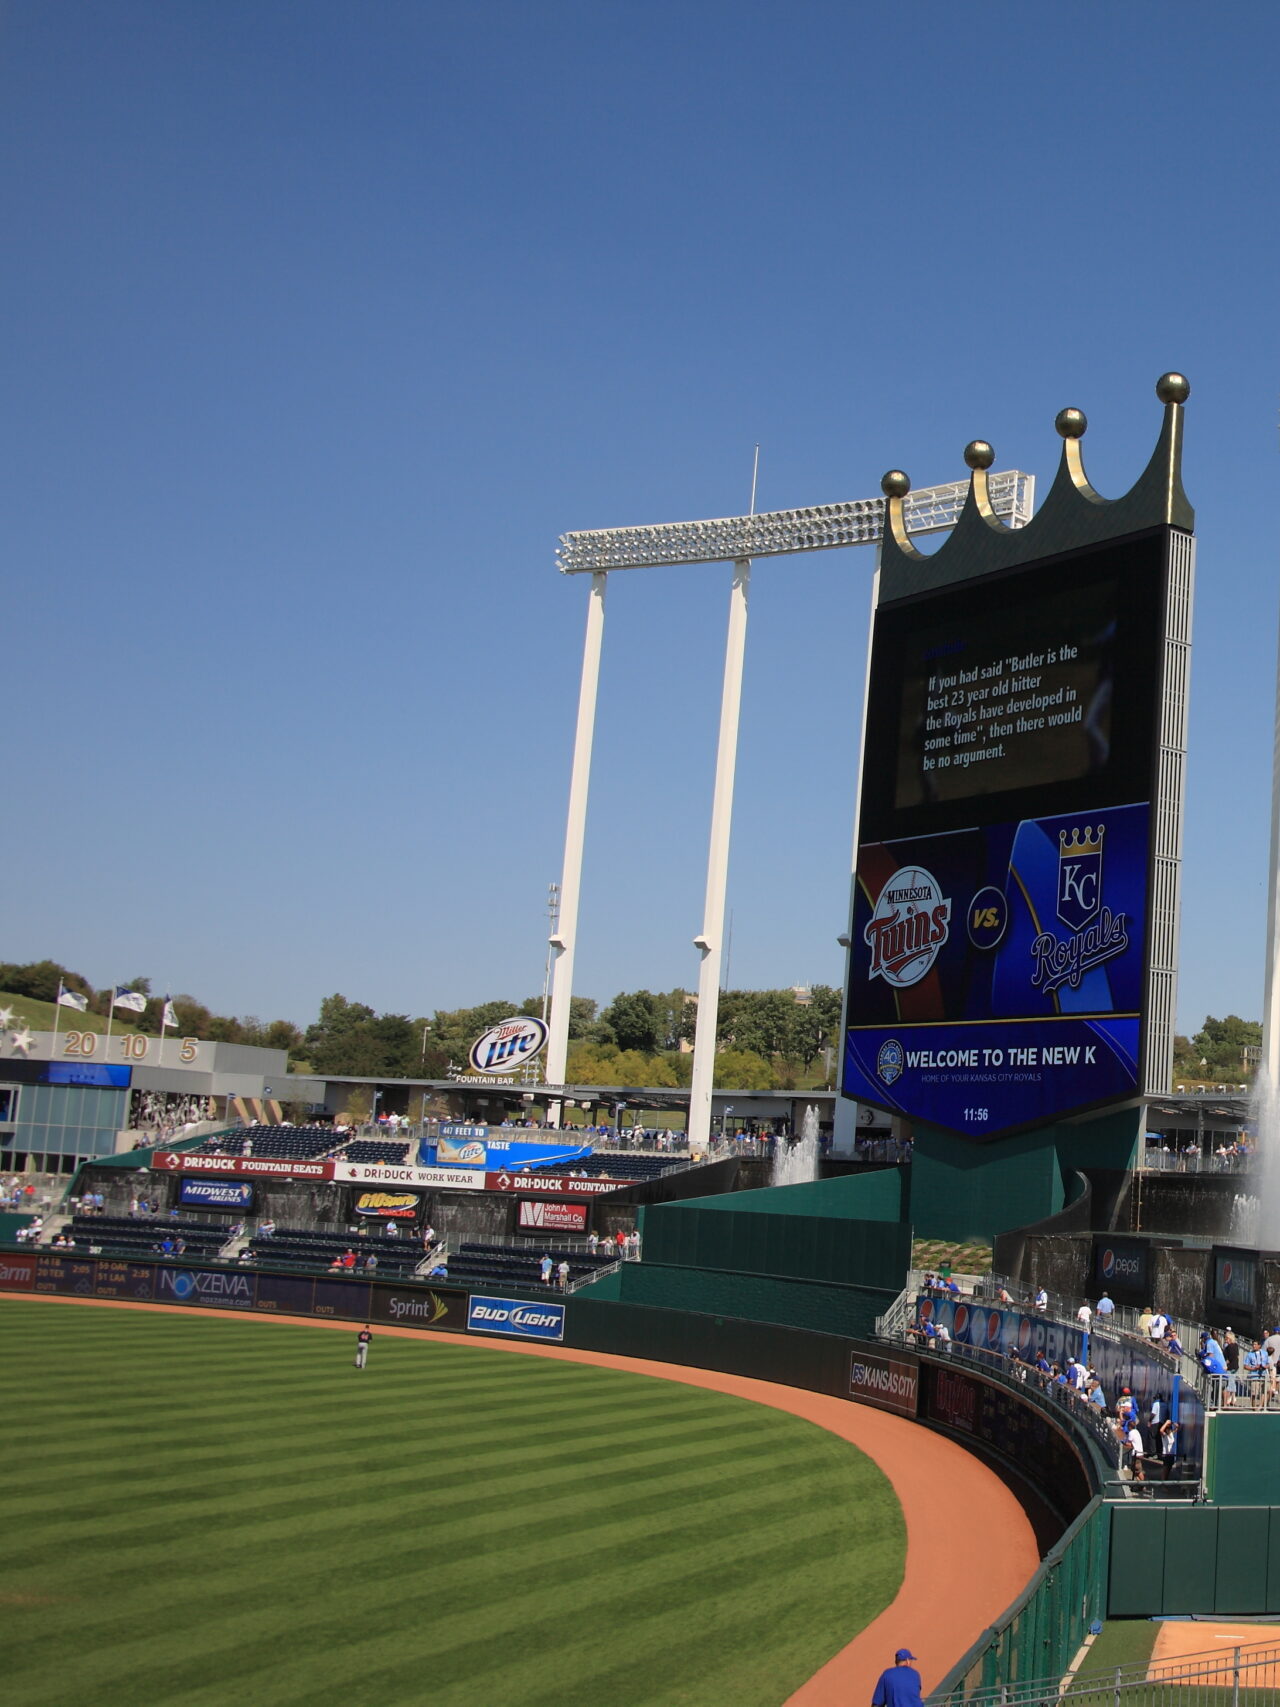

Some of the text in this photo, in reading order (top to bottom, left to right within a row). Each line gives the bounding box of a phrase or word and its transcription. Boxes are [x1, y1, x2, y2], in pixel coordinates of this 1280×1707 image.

[928, 644, 1078, 693] If you had said "Butler is the
[927, 675, 1042, 711] best 23 year old hitter
[926, 686, 1077, 731] the Royals have developed in
[924, 705, 1083, 751] some time", then there would
[923, 743, 1006, 771] be no argument.
[887, 886, 932, 904] MINNESOTA
[867, 904, 948, 973] Twins
[1031, 906, 1129, 994] Royals
[494, 1025, 527, 1040] Miller
[63, 1031, 98, 1056] 20
[120, 1034, 148, 1059] 10
[179, 1037, 199, 1062] 5
[484, 1033, 536, 1069] Lite
[906, 1049, 980, 1068] WELCOME
[982, 1049, 1004, 1067] TO
[1008, 1048, 1037, 1066] THE
[1042, 1046, 1080, 1065] NEW
[1085, 1046, 1097, 1064] K
[456, 1075, 514, 1085] FOUNTAIN BAR
[921, 1072, 1042, 1083] HOME OF YOUR KANSAS CITY ROYALS
[964, 1108, 988, 1121] 11:56
[455, 1127, 472, 1136] FEET
[474, 1128, 485, 1137] TO
[487, 1141, 510, 1150] TASTE
[241, 1161, 291, 1173] FOUNTAIN
[293, 1164, 323, 1174] SEATS
[418, 1172, 445, 1182] WORK
[446, 1174, 473, 1184] WEAR
[184, 1186, 241, 1197] MIDWEST
[568, 1182, 616, 1192] FOUNTAIN
[208, 1195, 241, 1203] AIRLINES
[545, 1203, 568, 1212] John A.
[544, 1212, 584, 1222] Marshall Co.
[49, 1269, 65, 1278] TEX
[1115, 1256, 1140, 1275] pepsi
[36, 1282, 57, 1291] OUTS
[96, 1287, 117, 1295] OUTS
[160, 1269, 250, 1297] NOXZEMA
[200, 1296, 251, 1307] noxzema.com
[258, 1301, 277, 1309] OUTS
[389, 1298, 429, 1318] Sprint
[471, 1306, 561, 1328] BUD LIGHT
[863, 1366, 898, 1393] KANSAS
[898, 1376, 916, 1399] CITY
